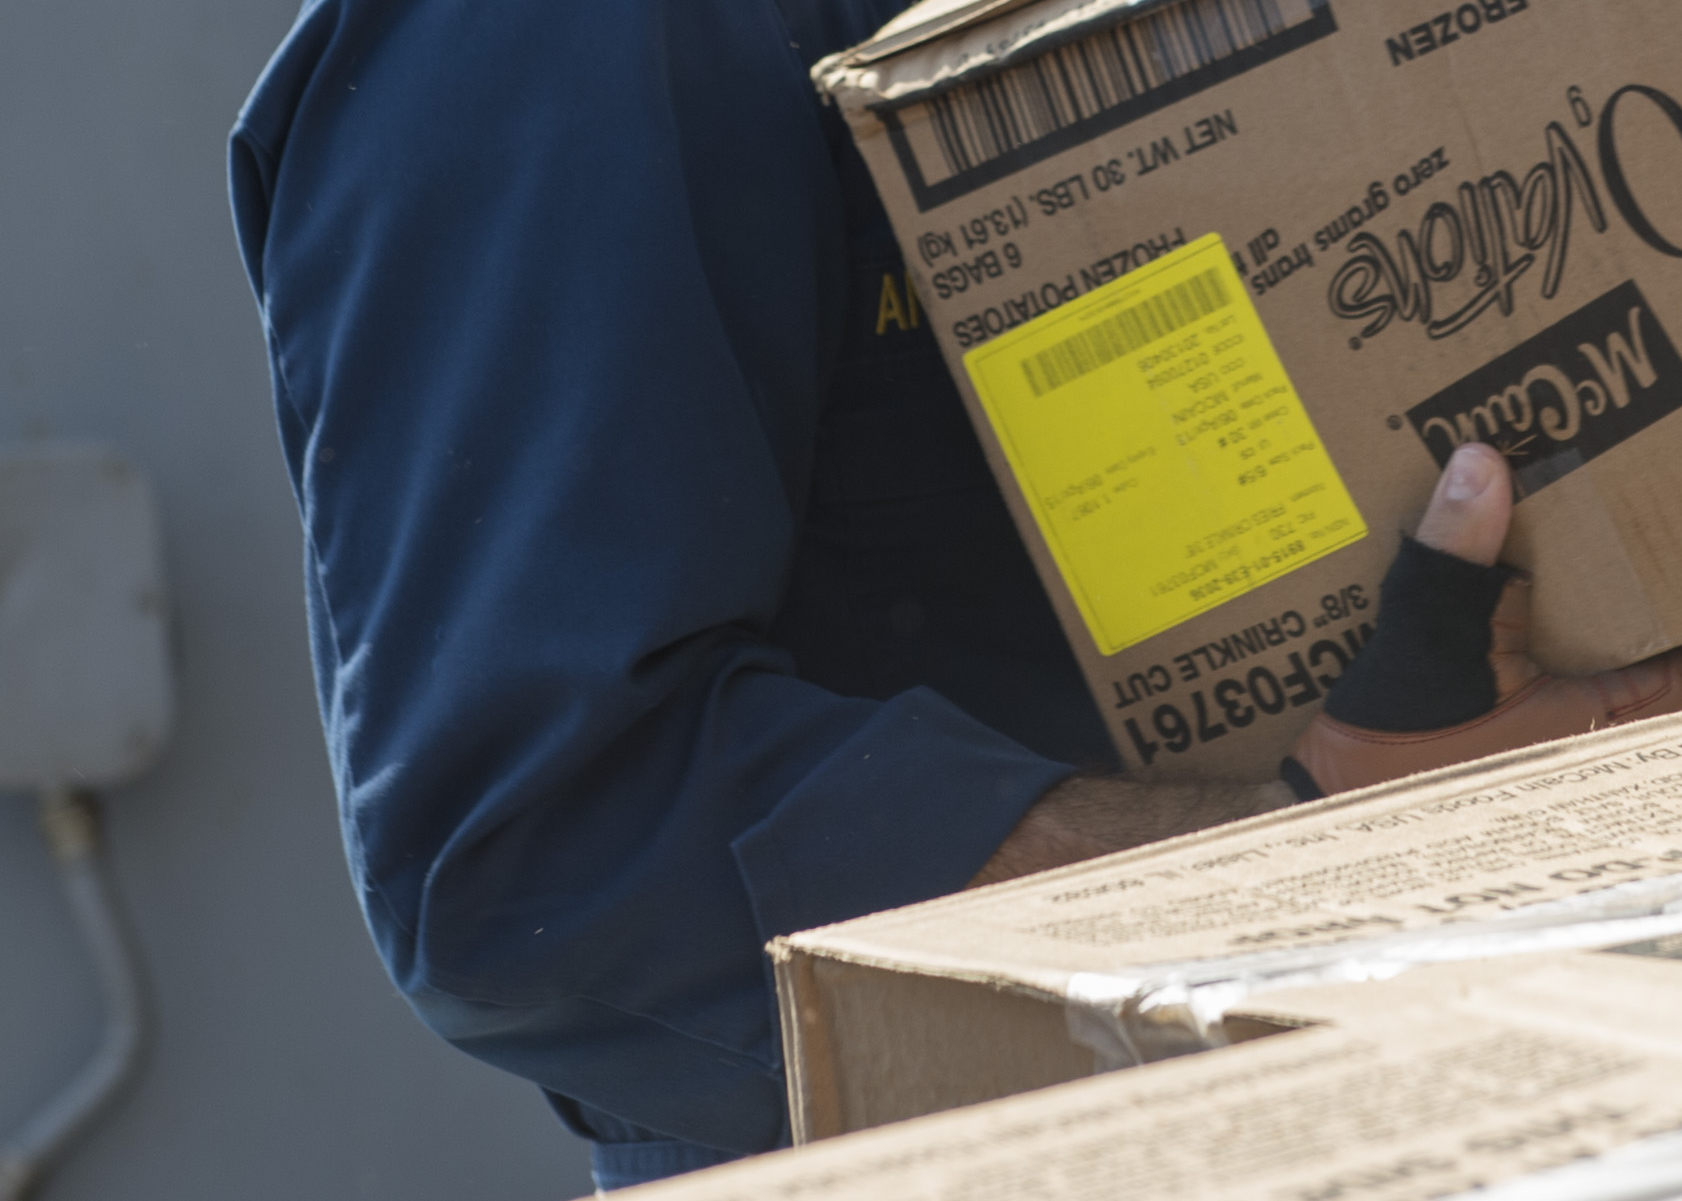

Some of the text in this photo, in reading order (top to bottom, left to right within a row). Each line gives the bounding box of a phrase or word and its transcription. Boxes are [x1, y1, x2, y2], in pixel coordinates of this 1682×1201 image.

[913, 107, 1239, 269] NET WT. 30 LBS. (13.61 kg)
[1391, 143, 1448, 197] zero
[1312, 182, 1389, 252] grams
[928, 240, 1024, 302] 6 BAGS
[1078, 226, 1187, 291] FROZEN
[1246, 226, 1280, 268] all
[1247, 241, 1315, 296] trans
[948, 273, 1079, 349] POTATOES
[1170, 606, 1308, 683] CRINKLE
[1106, 661, 1175, 709] CUT
[1418, 789, 1521, 817] Foods
[1509, 760, 1636, 794] McCain
